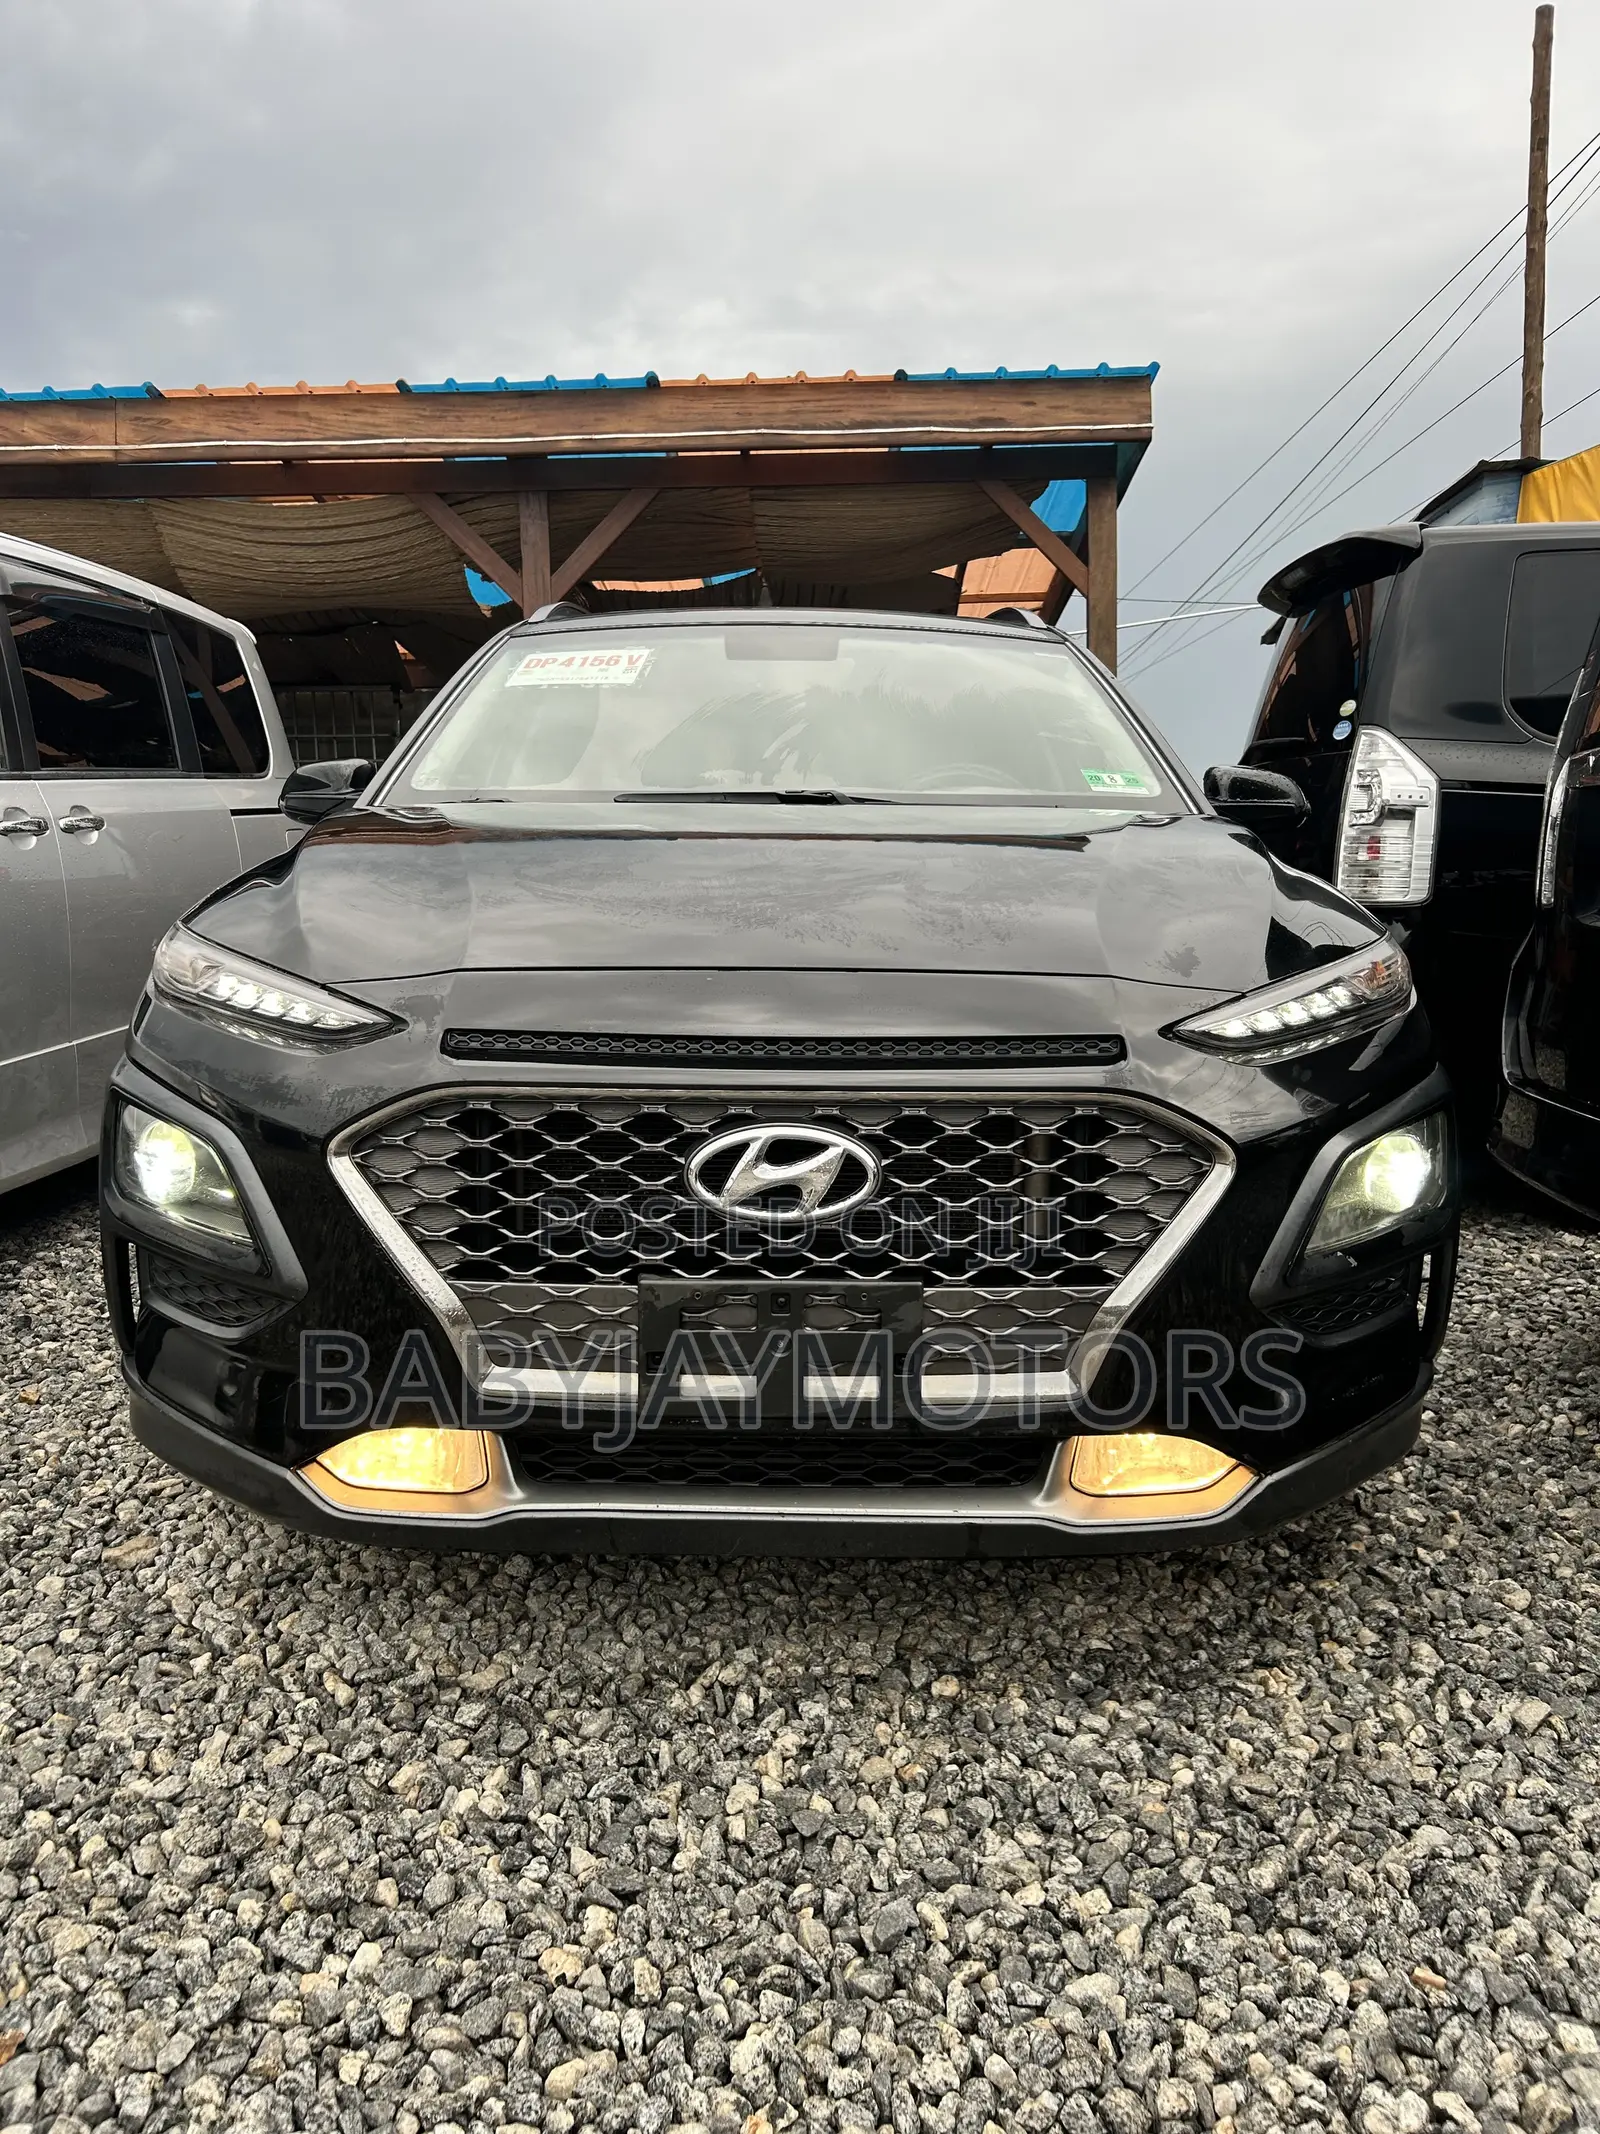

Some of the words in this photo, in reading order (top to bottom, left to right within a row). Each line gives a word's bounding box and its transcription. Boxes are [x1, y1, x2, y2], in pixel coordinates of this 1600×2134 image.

[523, 657, 558, 669] DP
[558, 655, 623, 668] 4156
[626, 654, 644, 666] V
[1088, 774, 1101, 782] 20
[1107, 774, 1118, 784] 8
